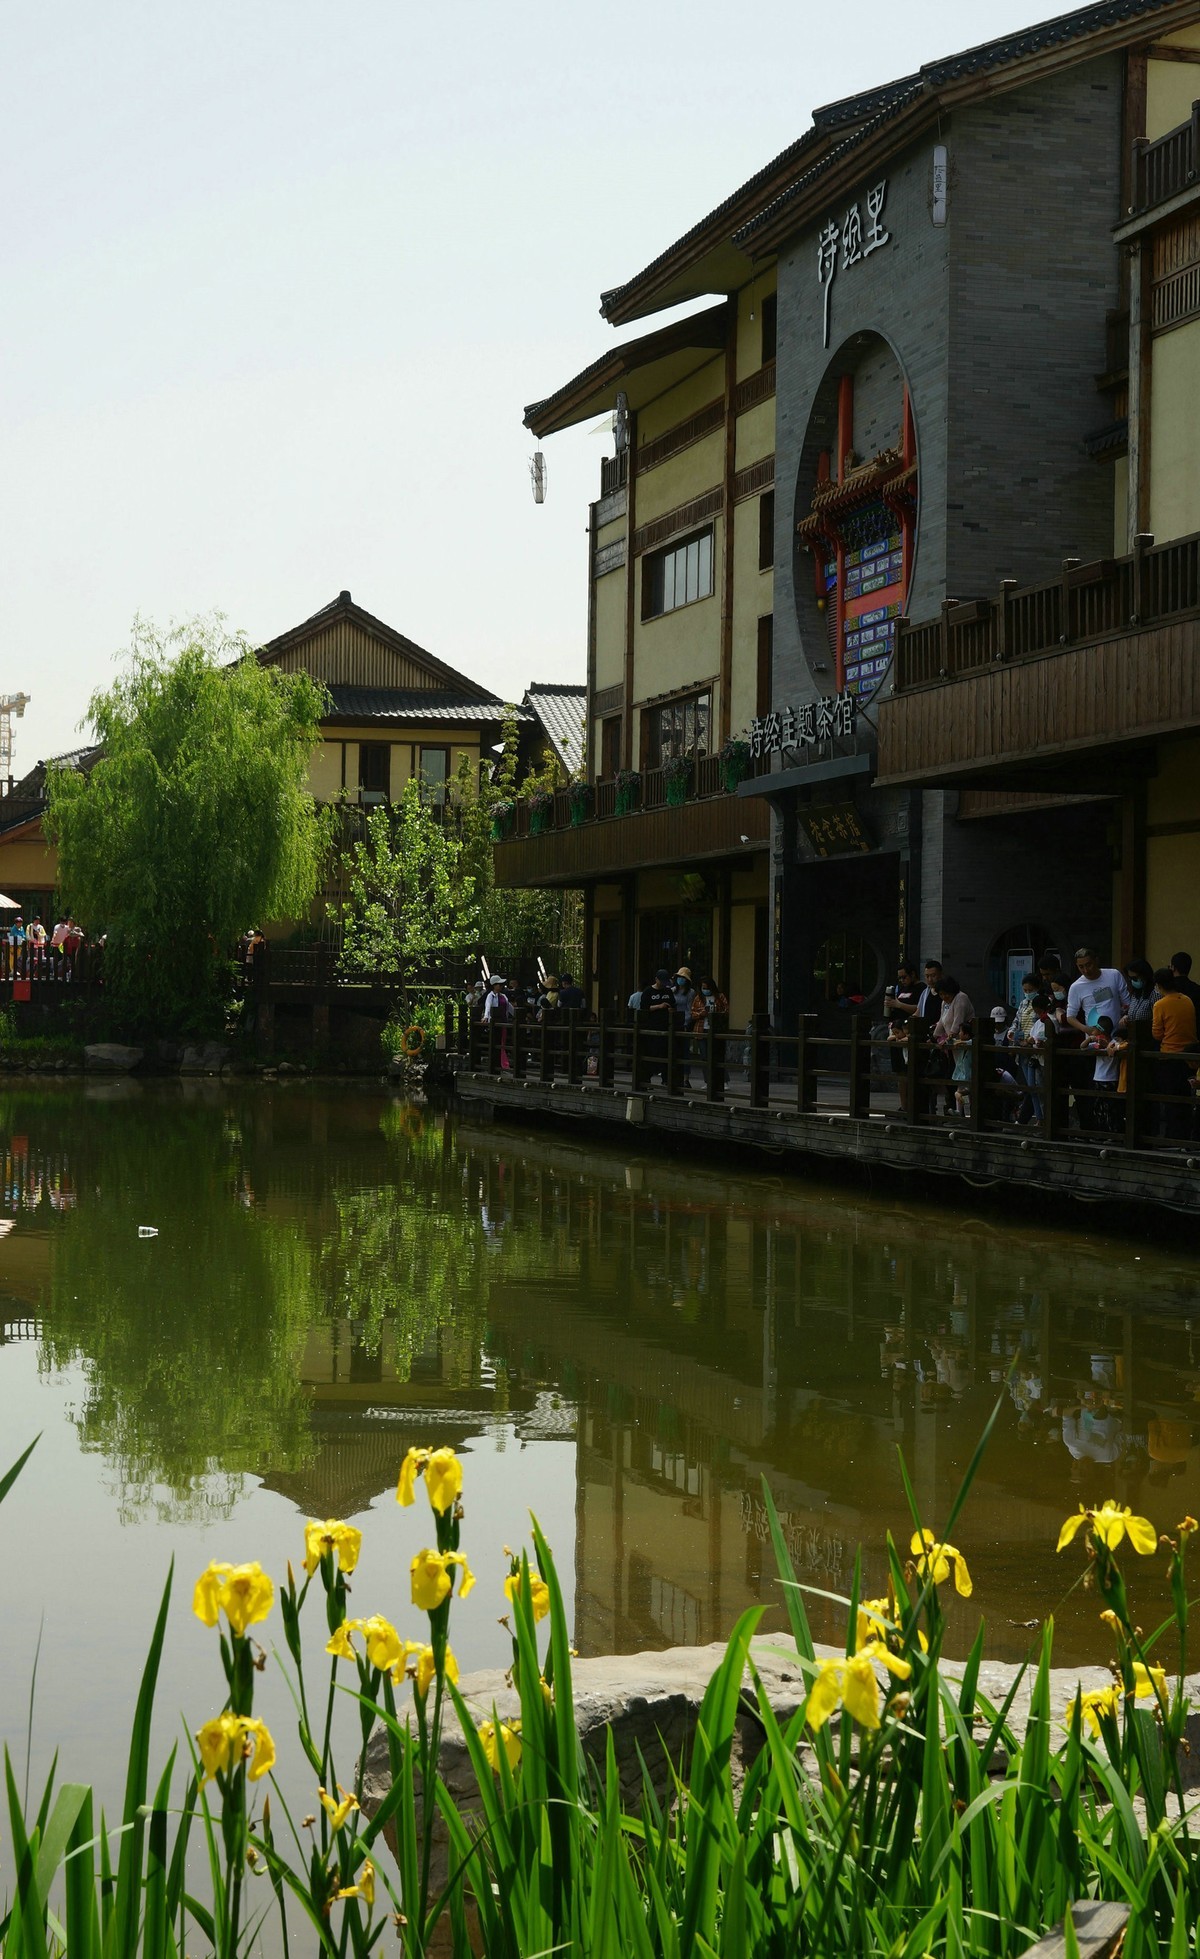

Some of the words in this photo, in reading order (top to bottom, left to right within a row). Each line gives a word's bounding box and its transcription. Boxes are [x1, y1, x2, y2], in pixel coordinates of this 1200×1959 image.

[748, 690, 854, 758] 诗经主题茶馆
